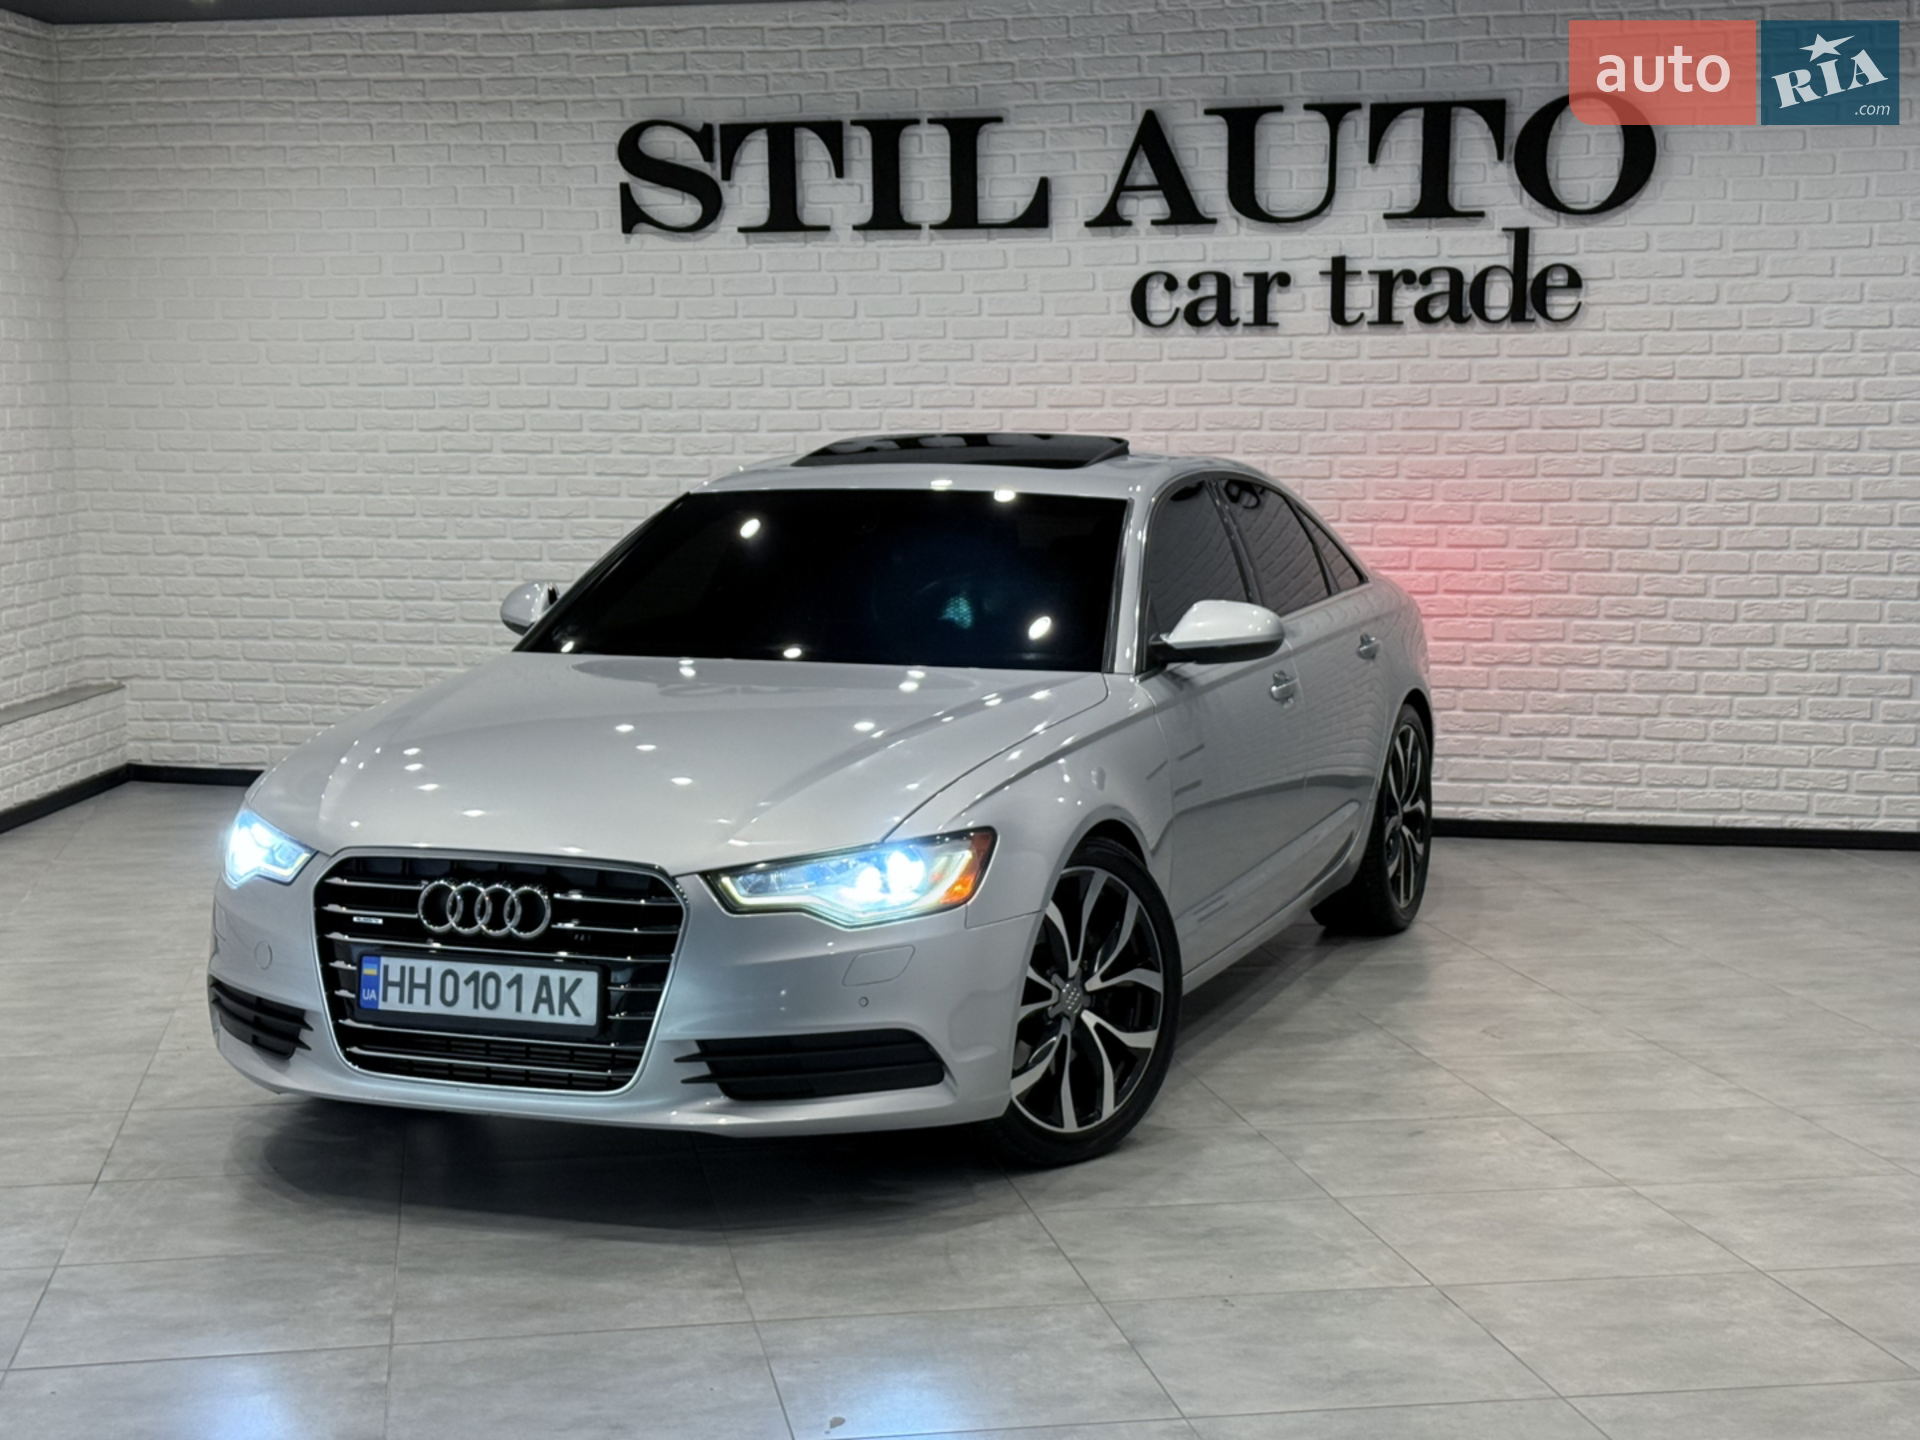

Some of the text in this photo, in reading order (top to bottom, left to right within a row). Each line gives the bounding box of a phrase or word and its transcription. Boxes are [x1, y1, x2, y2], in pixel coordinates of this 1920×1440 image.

[617, 92, 1657, 234] STIL AUTO
[1130, 226, 1583, 328] car trade
[362, 988, 378, 1001] UA
[382, 964, 583, 1018] HH 0101 AK
